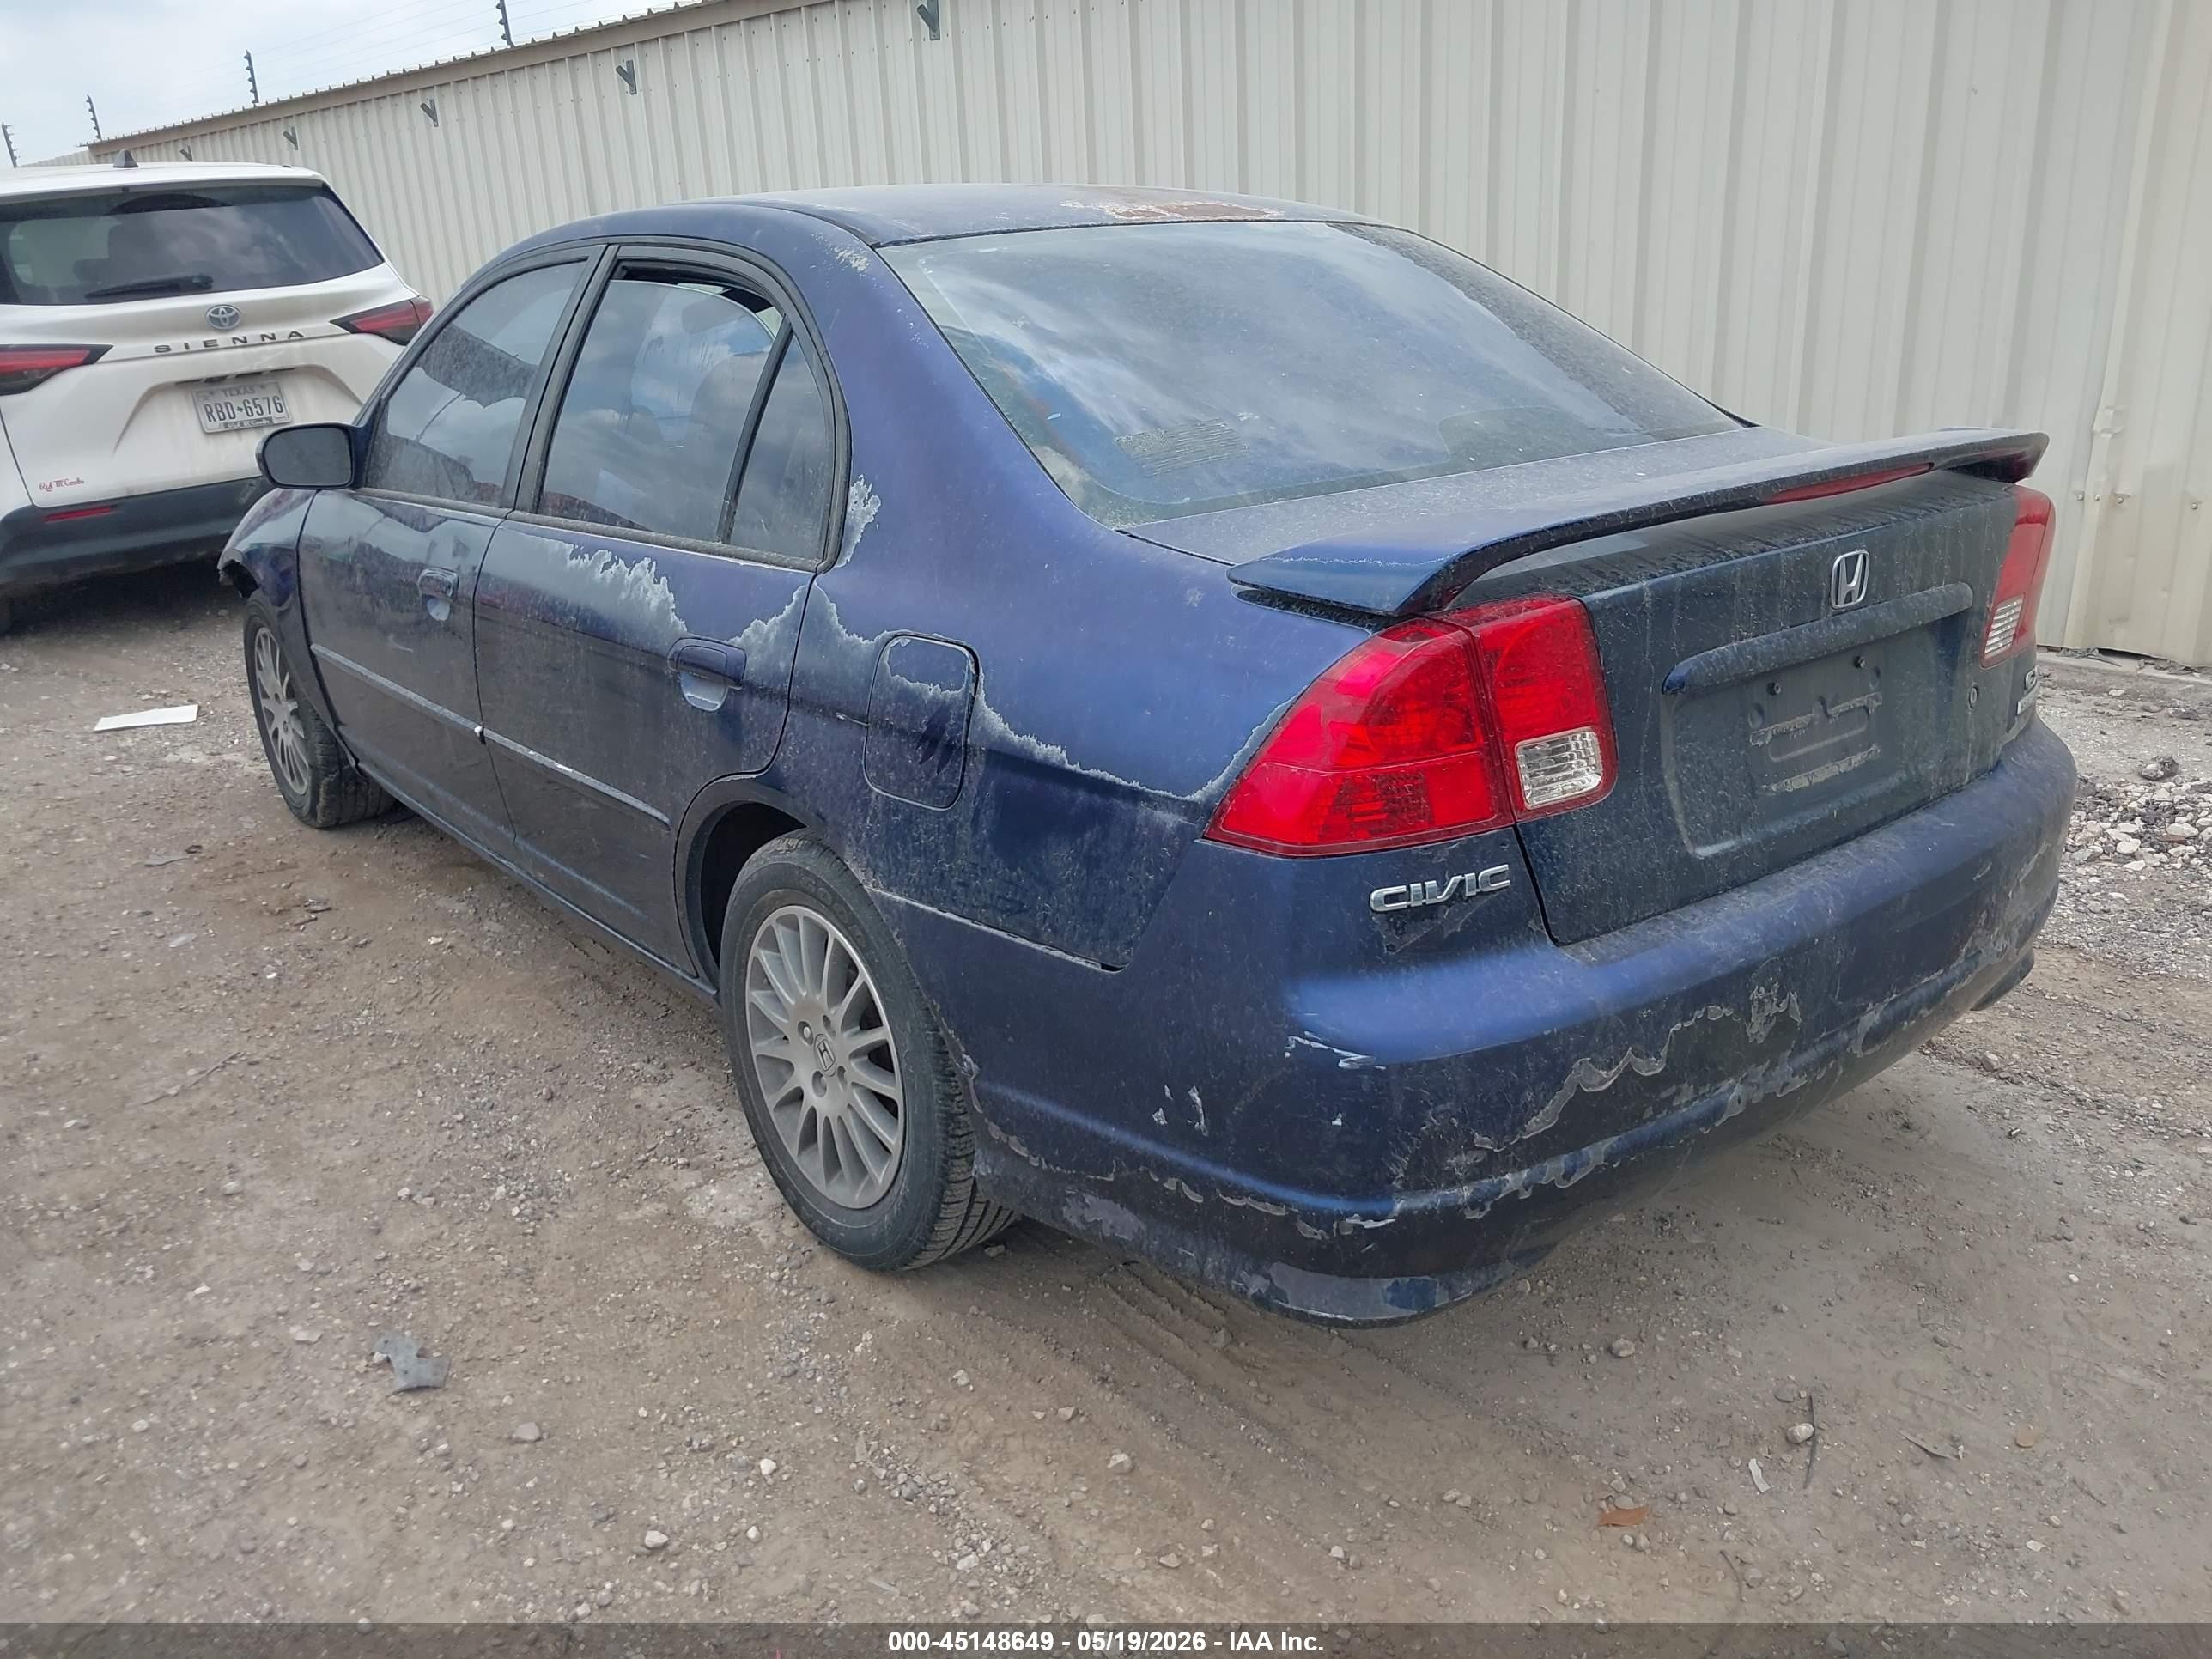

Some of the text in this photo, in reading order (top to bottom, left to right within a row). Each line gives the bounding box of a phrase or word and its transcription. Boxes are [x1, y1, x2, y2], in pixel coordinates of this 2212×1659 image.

[154, 331, 304, 354] SIENNA
[222, 385, 256, 397] TEXAS
[1370, 864, 1510, 912] CIVIC
